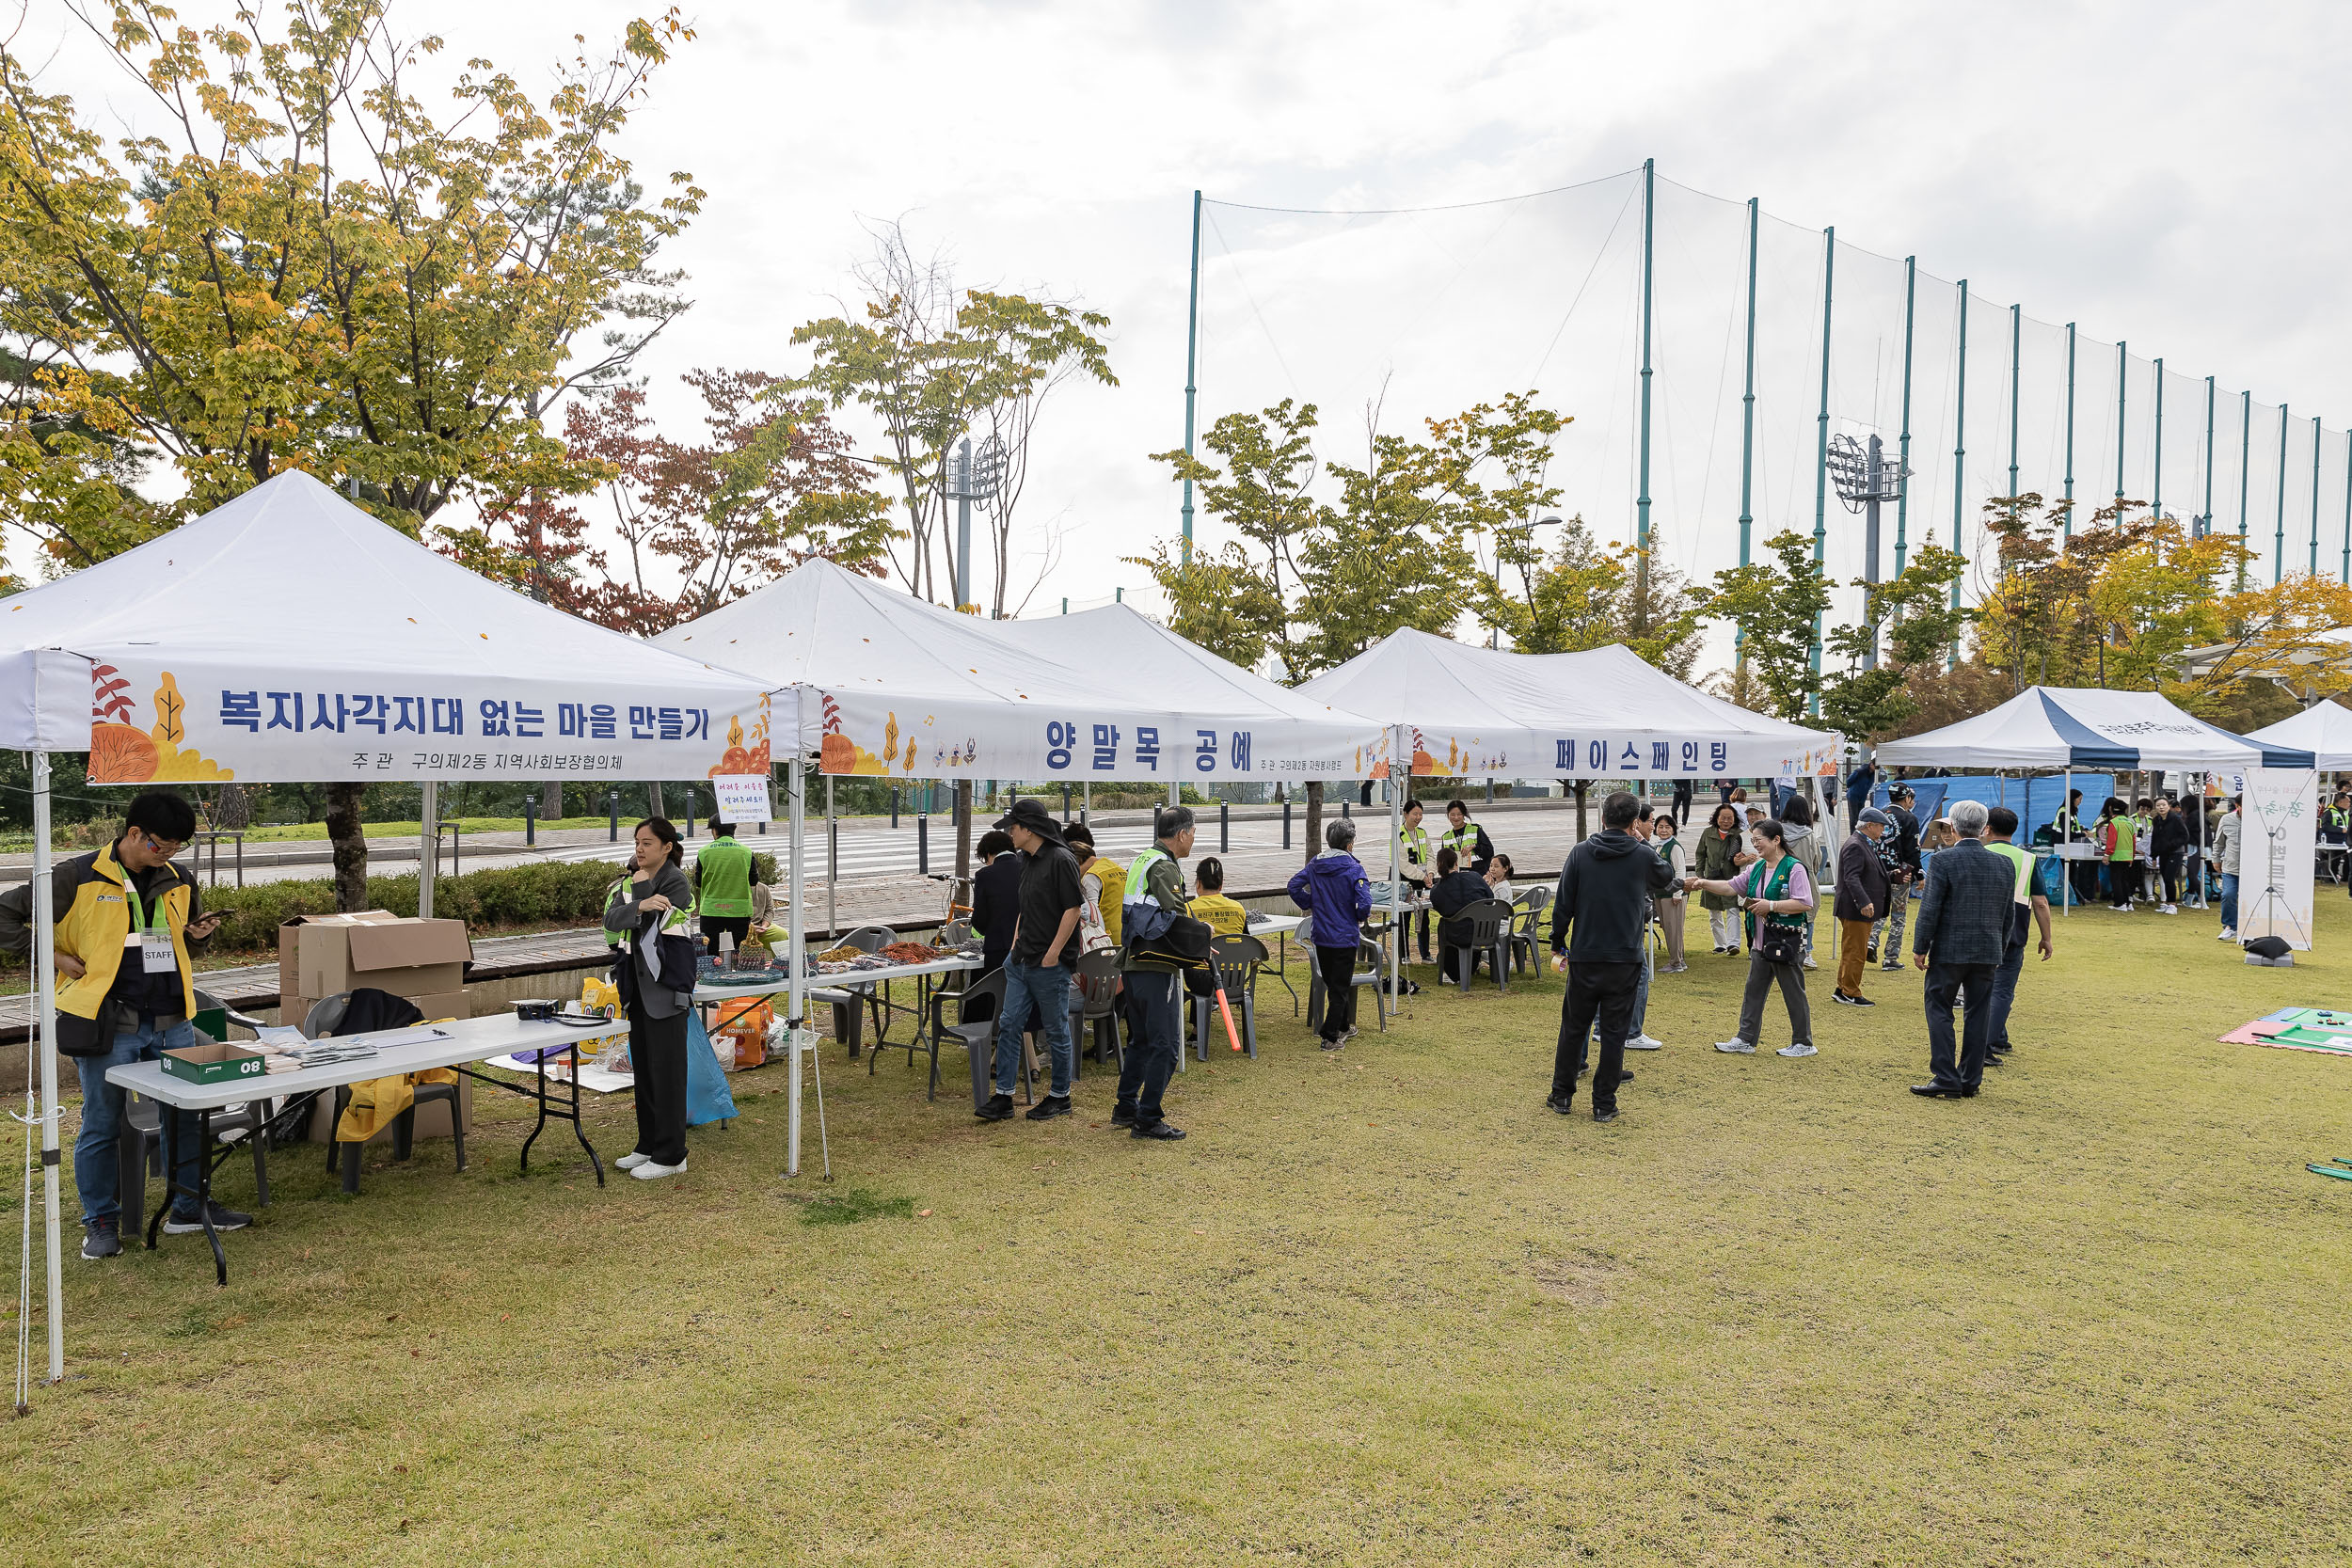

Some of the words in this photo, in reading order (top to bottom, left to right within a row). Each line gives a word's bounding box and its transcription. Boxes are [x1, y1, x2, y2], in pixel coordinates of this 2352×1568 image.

[220, 690, 464, 736] 복지사각지대
[480, 700, 545, 737] 없는
[558, 703, 617, 739] 마을
[628, 705, 709, 740] 만들기
[411, 753, 487, 770] 구의제2동
[494, 753, 623, 770] 지역사회보장협의체
[1555, 739, 1727, 771] 페이스페인팅
[1279, 760, 1307, 771] 구의제2동
[1309, 760, 1342, 771] 자원봉사캠프
[145, 951, 172, 959] STAFF
[163, 1057, 172, 1070] 08
[240, 1060, 261, 1074] 08
